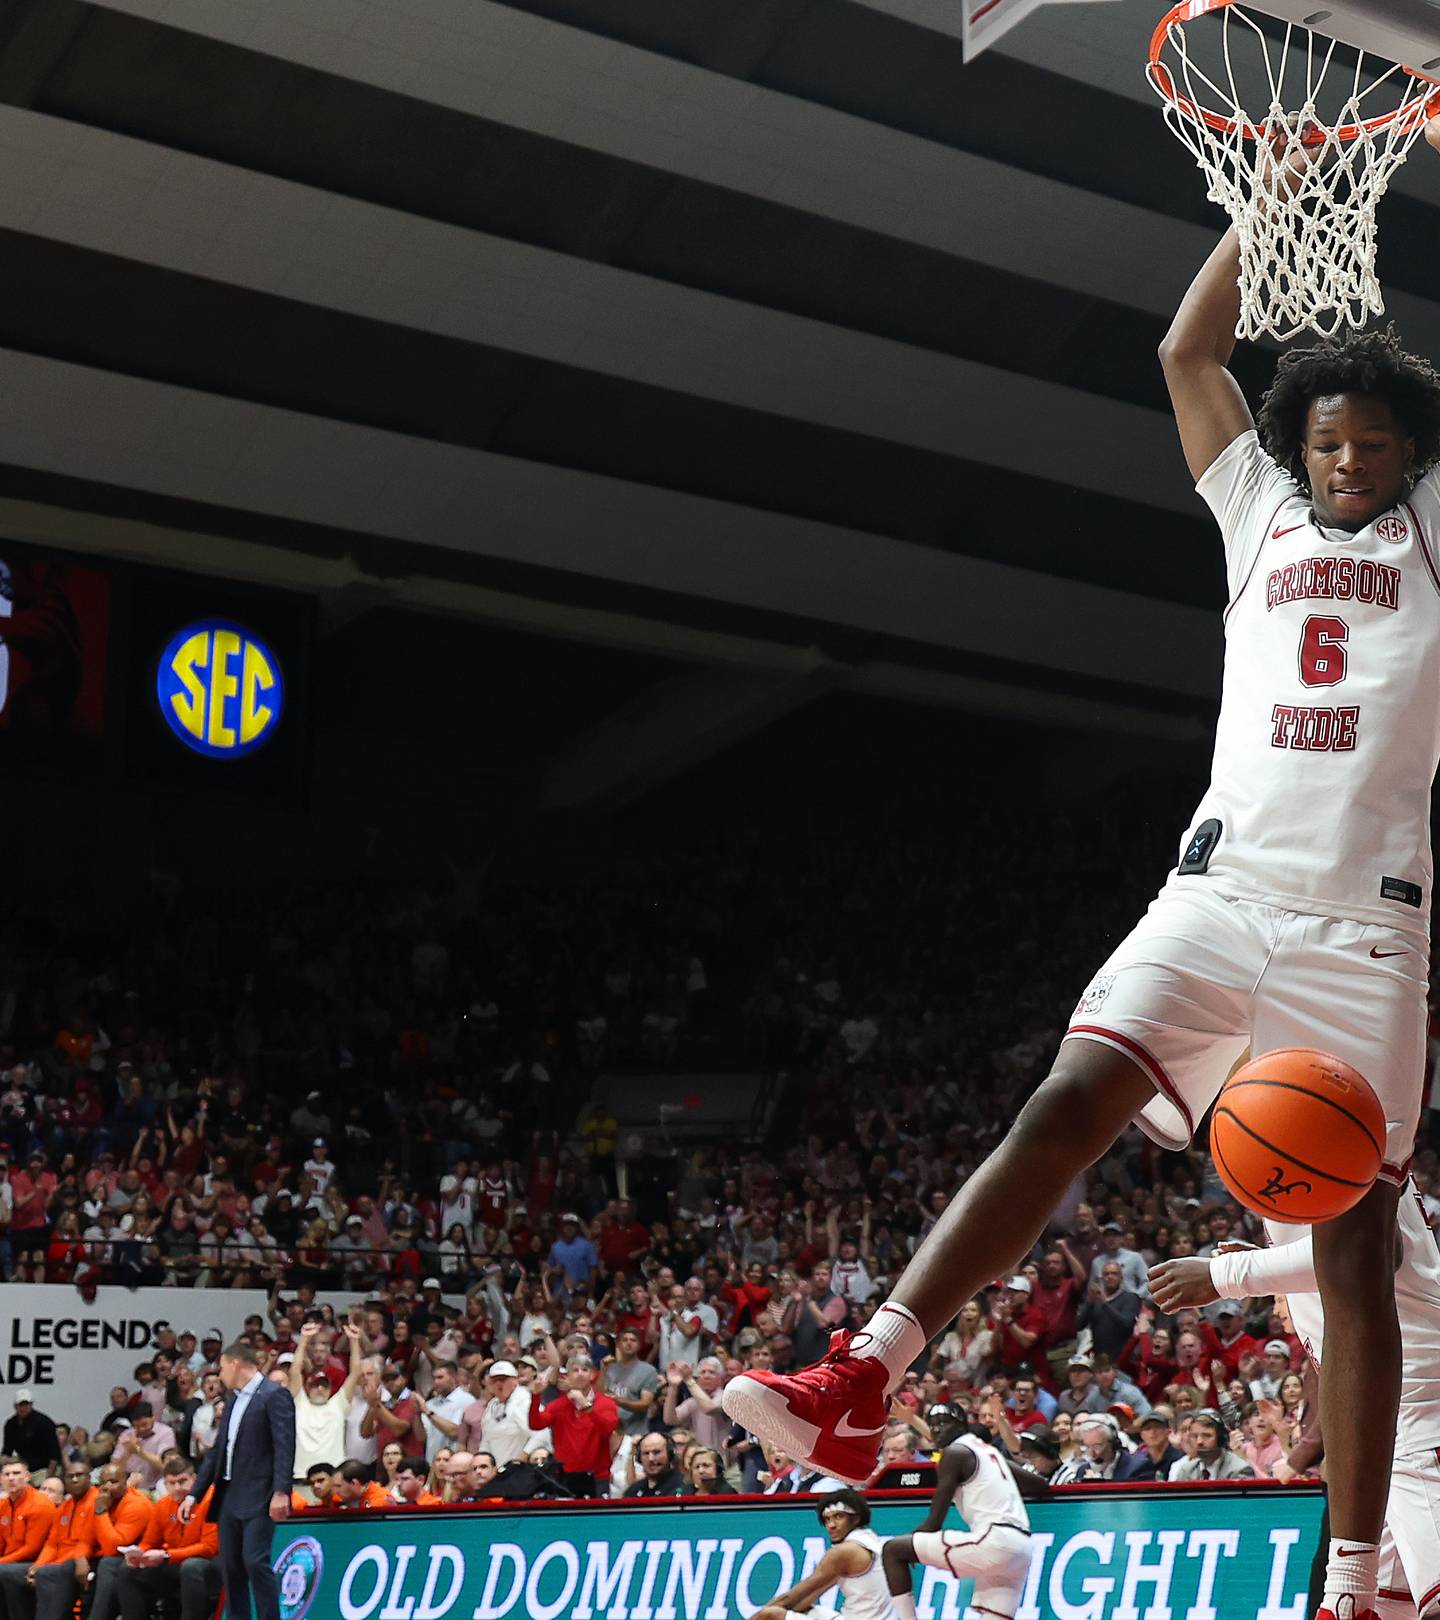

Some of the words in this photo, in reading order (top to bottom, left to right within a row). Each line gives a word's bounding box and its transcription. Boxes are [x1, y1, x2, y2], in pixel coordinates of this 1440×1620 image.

[1378, 519, 1406, 540] SEC
[1266, 557, 1400, 612] CRIMSON
[1298, 614, 1349, 688] 6
[170, 629, 275, 748] SEC
[1271, 704, 1360, 752] TIDE
[0, 1354, 55, 1385] DE
[339, 1543, 466, 1620] OLD
